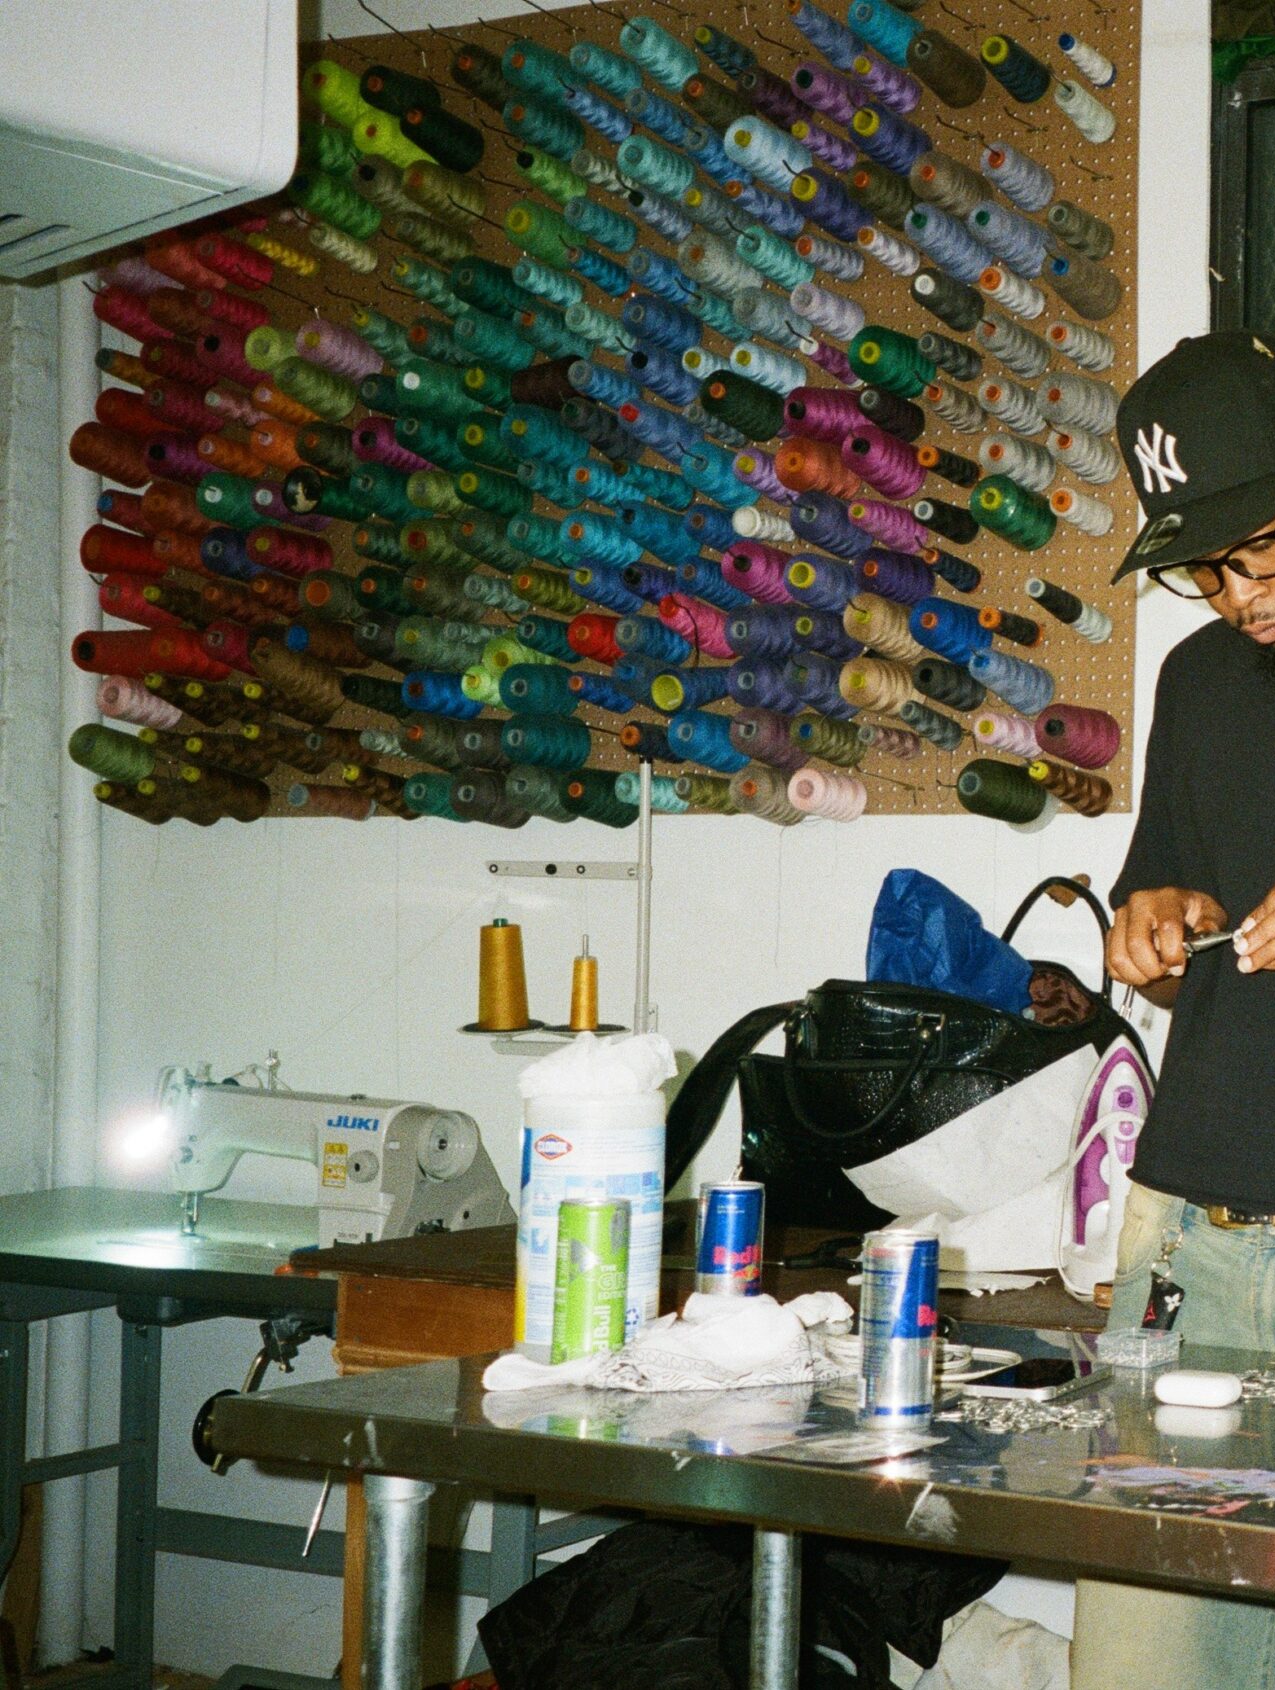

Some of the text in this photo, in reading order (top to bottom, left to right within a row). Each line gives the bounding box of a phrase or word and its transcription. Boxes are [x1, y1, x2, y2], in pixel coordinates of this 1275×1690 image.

[1134, 422, 1188, 493] NY
[327, 1115, 379, 1131] JUKI
[918, 1305, 937, 1326] Re
